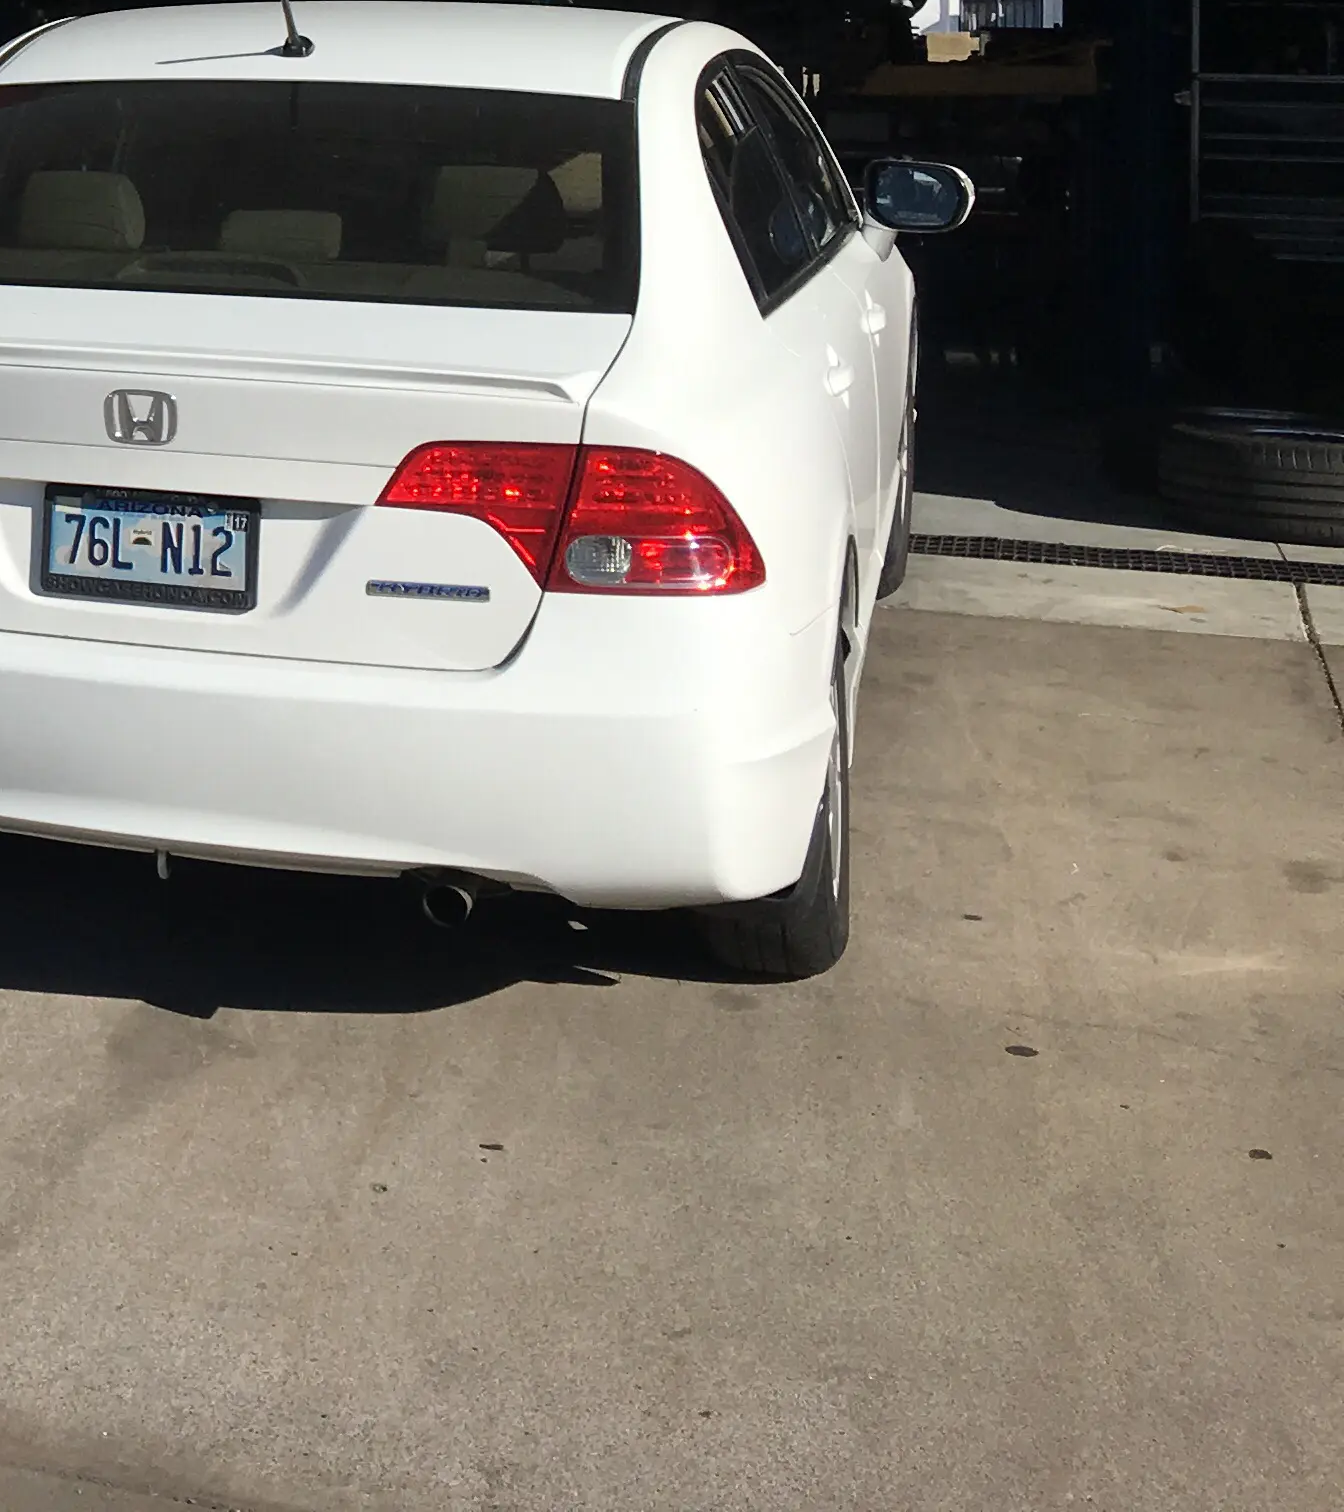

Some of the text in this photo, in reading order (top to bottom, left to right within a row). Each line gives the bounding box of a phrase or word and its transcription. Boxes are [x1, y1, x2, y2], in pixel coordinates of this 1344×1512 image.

[95, 498, 204, 518] ARIZONA
[234, 515, 248, 527] 17
[64, 513, 236, 578] 76L N12
